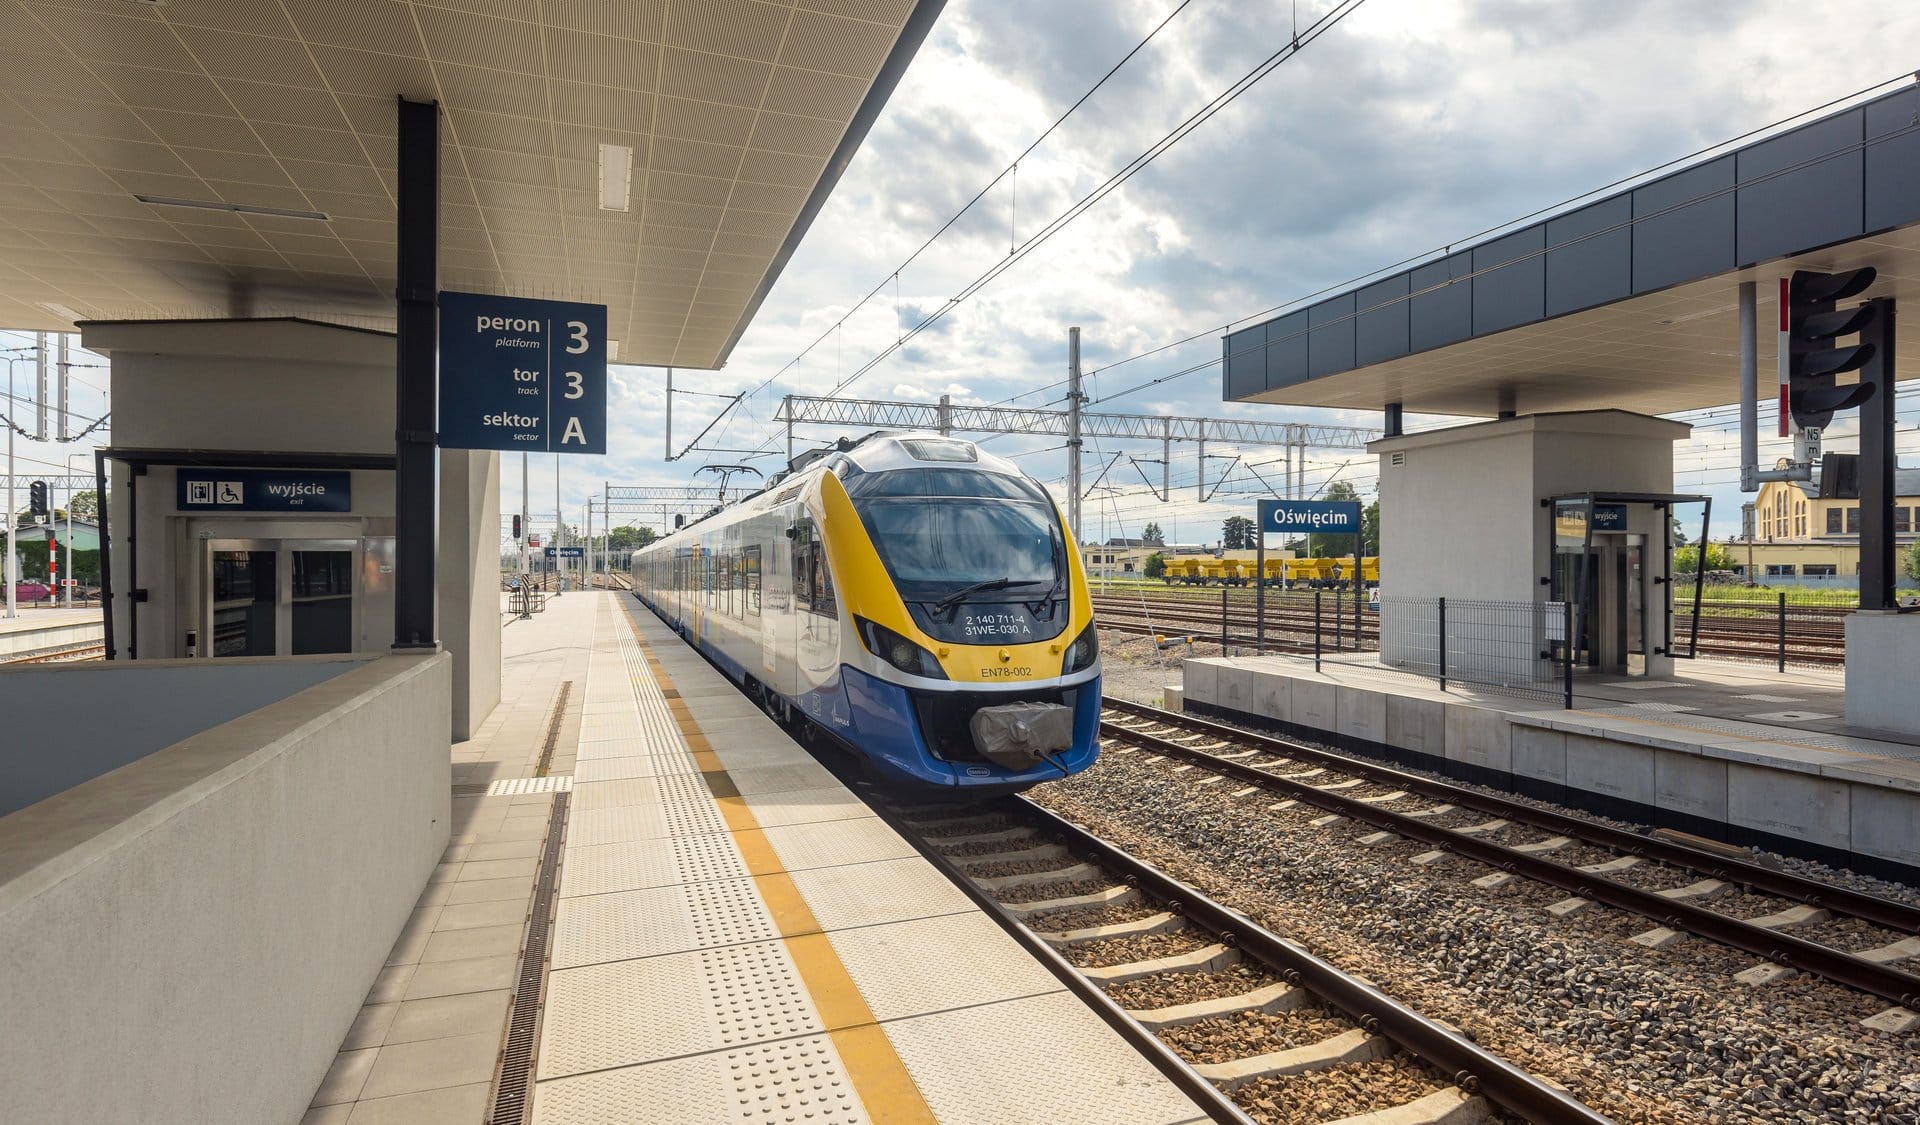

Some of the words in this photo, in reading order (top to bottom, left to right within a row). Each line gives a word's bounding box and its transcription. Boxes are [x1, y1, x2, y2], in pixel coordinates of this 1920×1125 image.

[477, 315, 540, 333] peron
[565, 321, 589, 354] 3
[495, 337, 540, 348] platform
[513, 368, 540, 382] tor
[564, 371, 584, 399] 3
[518, 387, 540, 395] track
[483, 412, 540, 428] sektor
[561, 416, 587, 445] A
[1807, 428, 1819, 440] N5
[513, 432, 540, 441] sector
[269, 482, 326, 497] wyjście
[1274, 508, 1348, 528] Oświęcim
[1594, 512, 1618, 522] wyjście
[966, 616, 974, 625] 2
[976, 615, 995, 624] 140
[996, 614, 1025, 624] 711-4
[965, 624, 1018, 636] 31WE-030
[1022, 626, 1031, 634] A
[981, 667, 1032, 678] EN78-002
